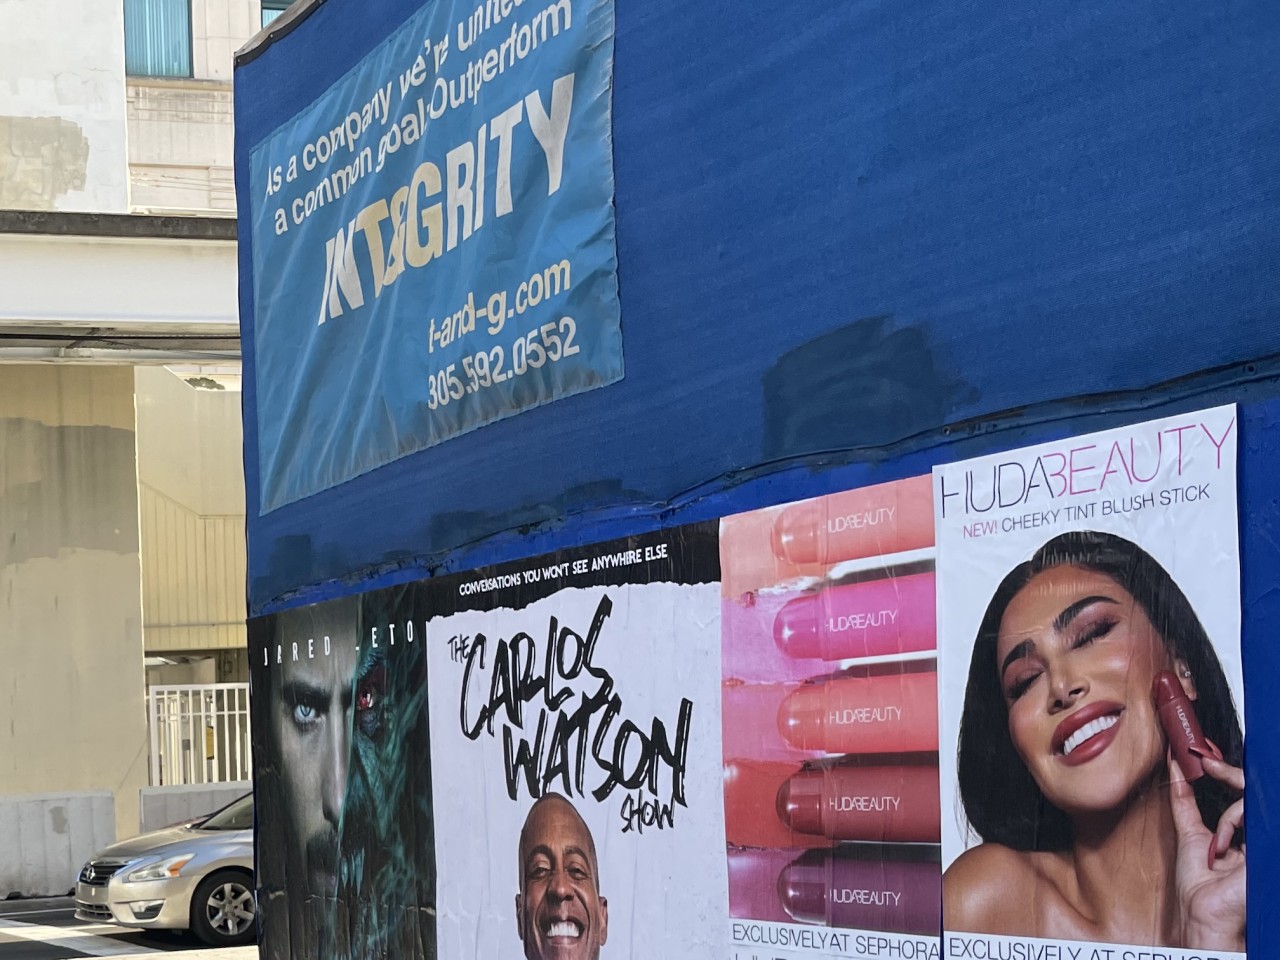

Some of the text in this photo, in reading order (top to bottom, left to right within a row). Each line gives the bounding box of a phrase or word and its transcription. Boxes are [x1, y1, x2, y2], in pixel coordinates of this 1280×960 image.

[274, 207, 289, 236] a
[291, 146, 372, 225] common
[428, 0, 572, 120] Outperform
[286, 154, 298, 183] a
[302, 81, 392, 172] company
[457, 0, 524, 52] unite
[428, 258, 571, 354] t-and-g.com
[427, 316, 581, 410] 305.592.0552
[963, 482, 1211, 539] NEW! CHEEKY TINT BLUSH STICK
[459, 572, 521, 597] CONVERSATIONS
[522, 568, 541, 585] YOU
[572, 559, 589, 575] SEE
[645, 543, 669, 562] ELSE
[263, 619, 415, 667] JARED ETO
[448, 634, 471, 664] THE
[460, 593, 614, 740] CARLOS
[502, 692, 693, 808] WATSON
[620, 789, 675, 836] SHOW
[732, 923, 940, 960] EXCLUSIVELY AT SEPHORA
